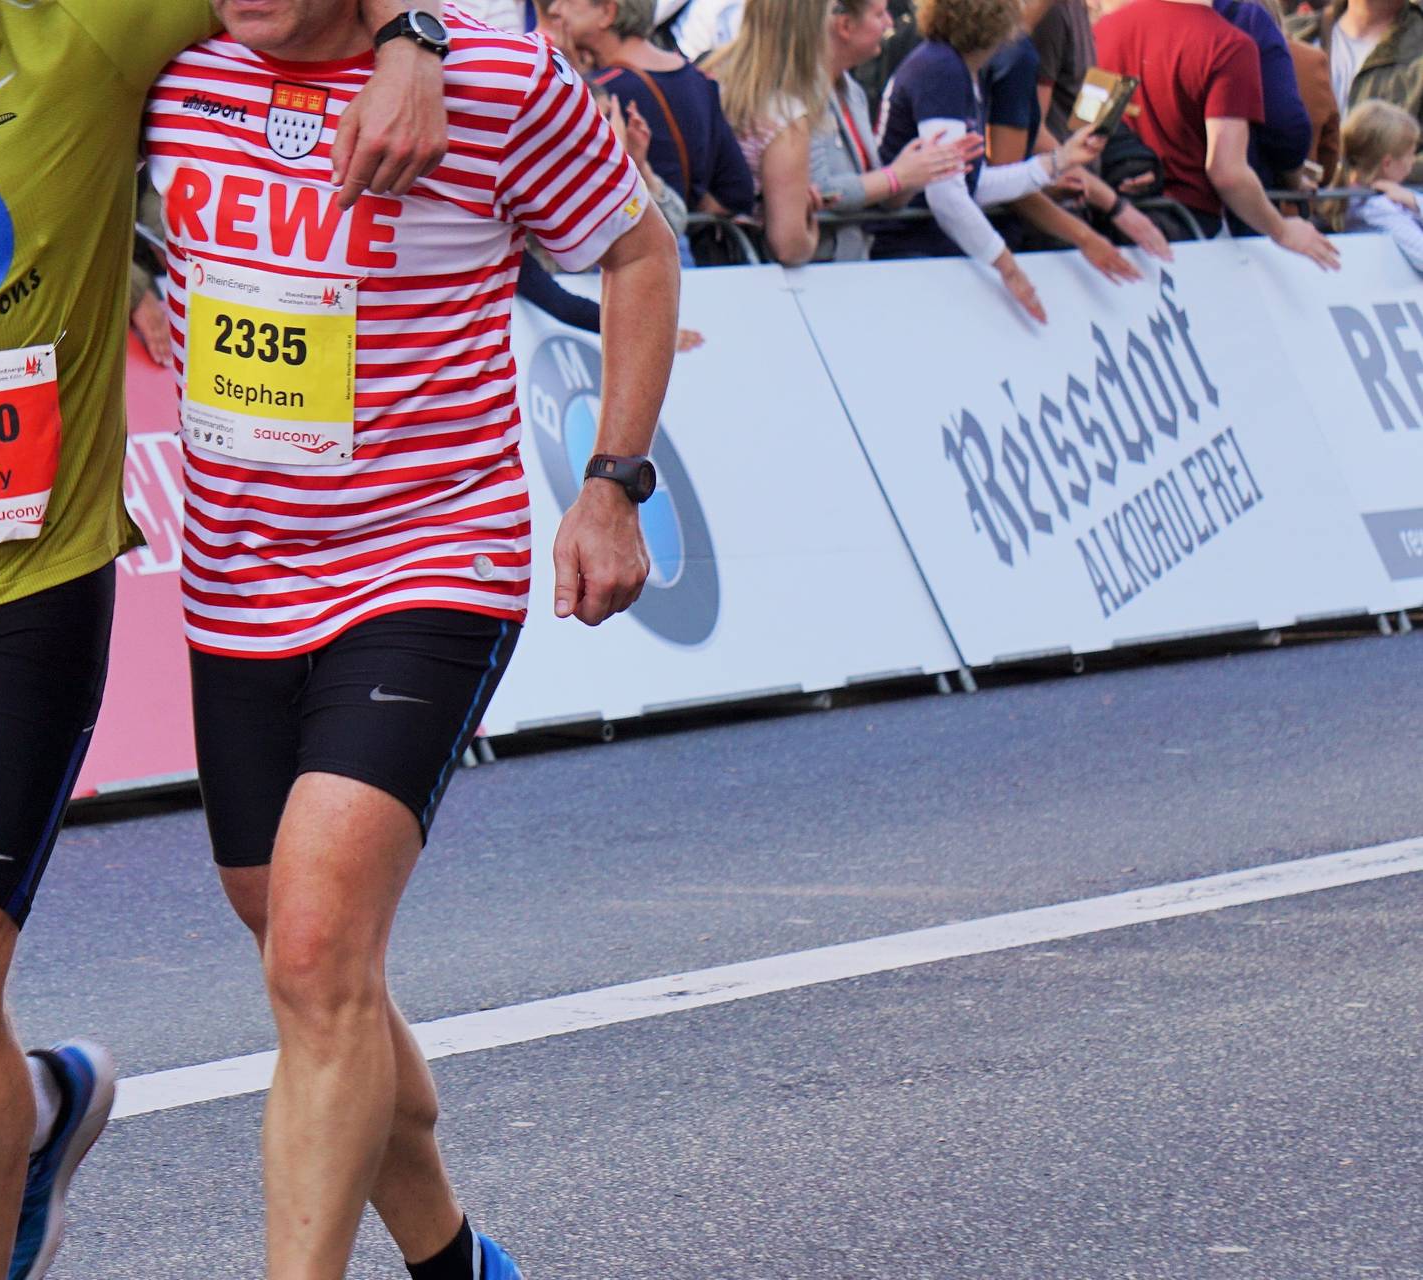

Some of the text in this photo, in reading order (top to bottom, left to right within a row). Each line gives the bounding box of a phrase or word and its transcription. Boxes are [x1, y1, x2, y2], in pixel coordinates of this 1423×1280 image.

[165, 167, 402, 269] REWE
[206, 273, 261, 294] RheinEnergie
[214, 313, 307, 366] 2335
[1328, 301, 1423, 432] RE
[213, 374, 304, 407] Stephan
[941, 267, 1220, 568] Reissdorf
[253, 428, 321, 446] saucony
[1075, 426, 1264, 620] ALKOHOLFREI
